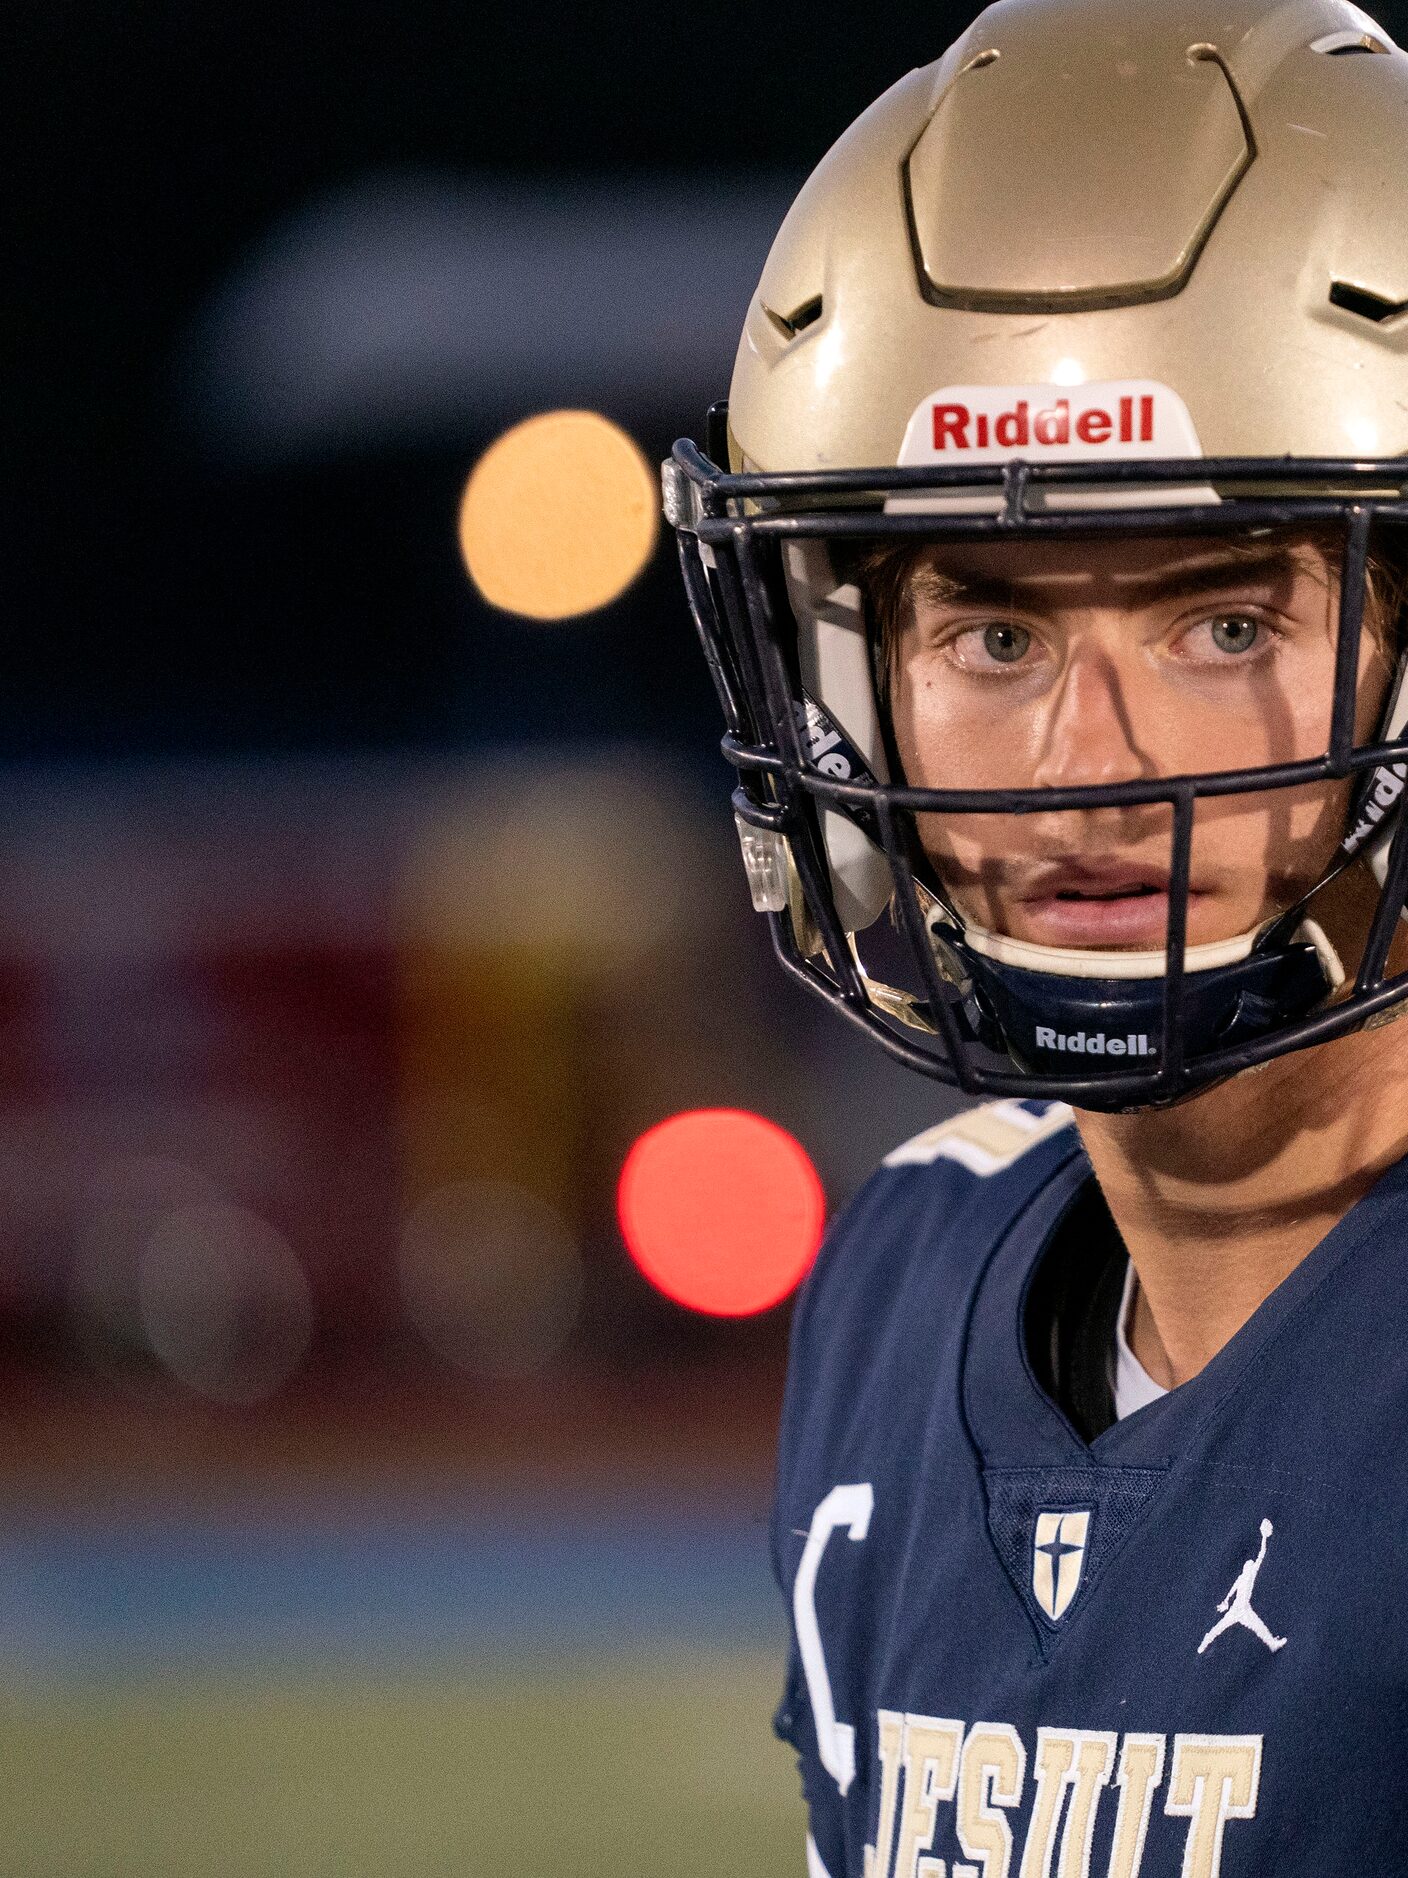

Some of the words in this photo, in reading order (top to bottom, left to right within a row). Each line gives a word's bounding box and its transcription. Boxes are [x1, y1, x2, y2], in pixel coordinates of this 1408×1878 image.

[931, 395, 1154, 450] Riddell
[1035, 1025, 1148, 1056] Riddell
[863, 1708, 1265, 1878] JESUIT
